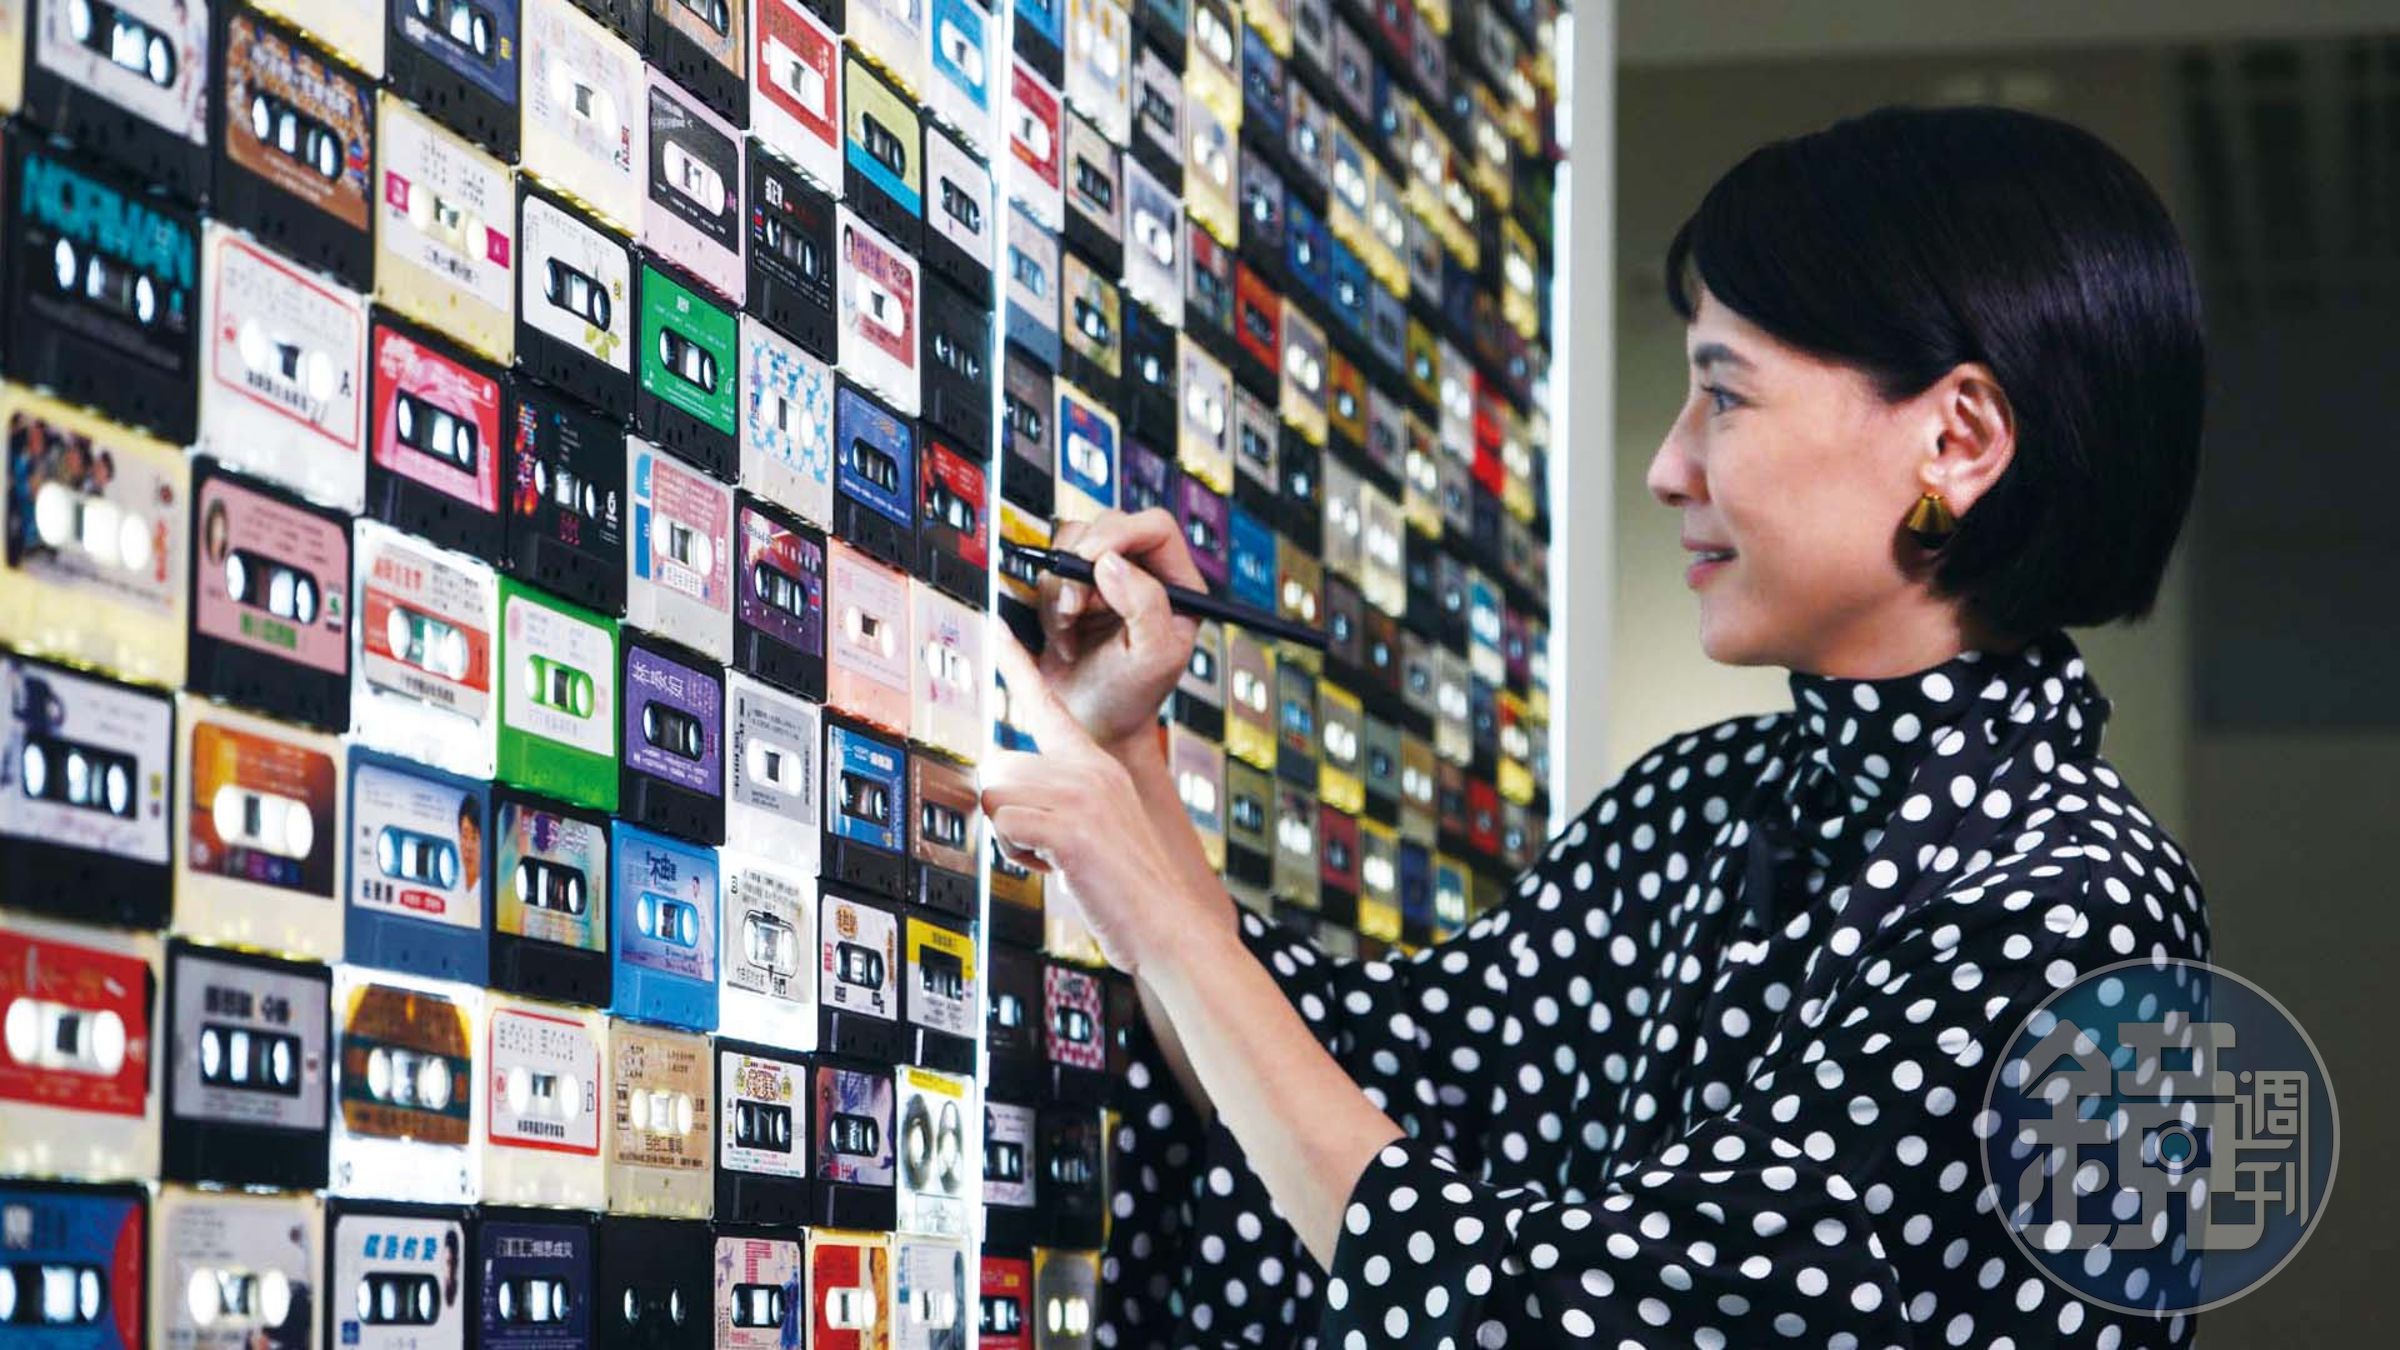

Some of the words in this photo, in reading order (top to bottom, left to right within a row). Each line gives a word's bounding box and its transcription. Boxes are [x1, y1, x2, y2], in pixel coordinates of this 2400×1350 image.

[22, 152, 194, 290] NORMAN
[340, 370, 352, 397] A
[586, 1081, 596, 1113] B
